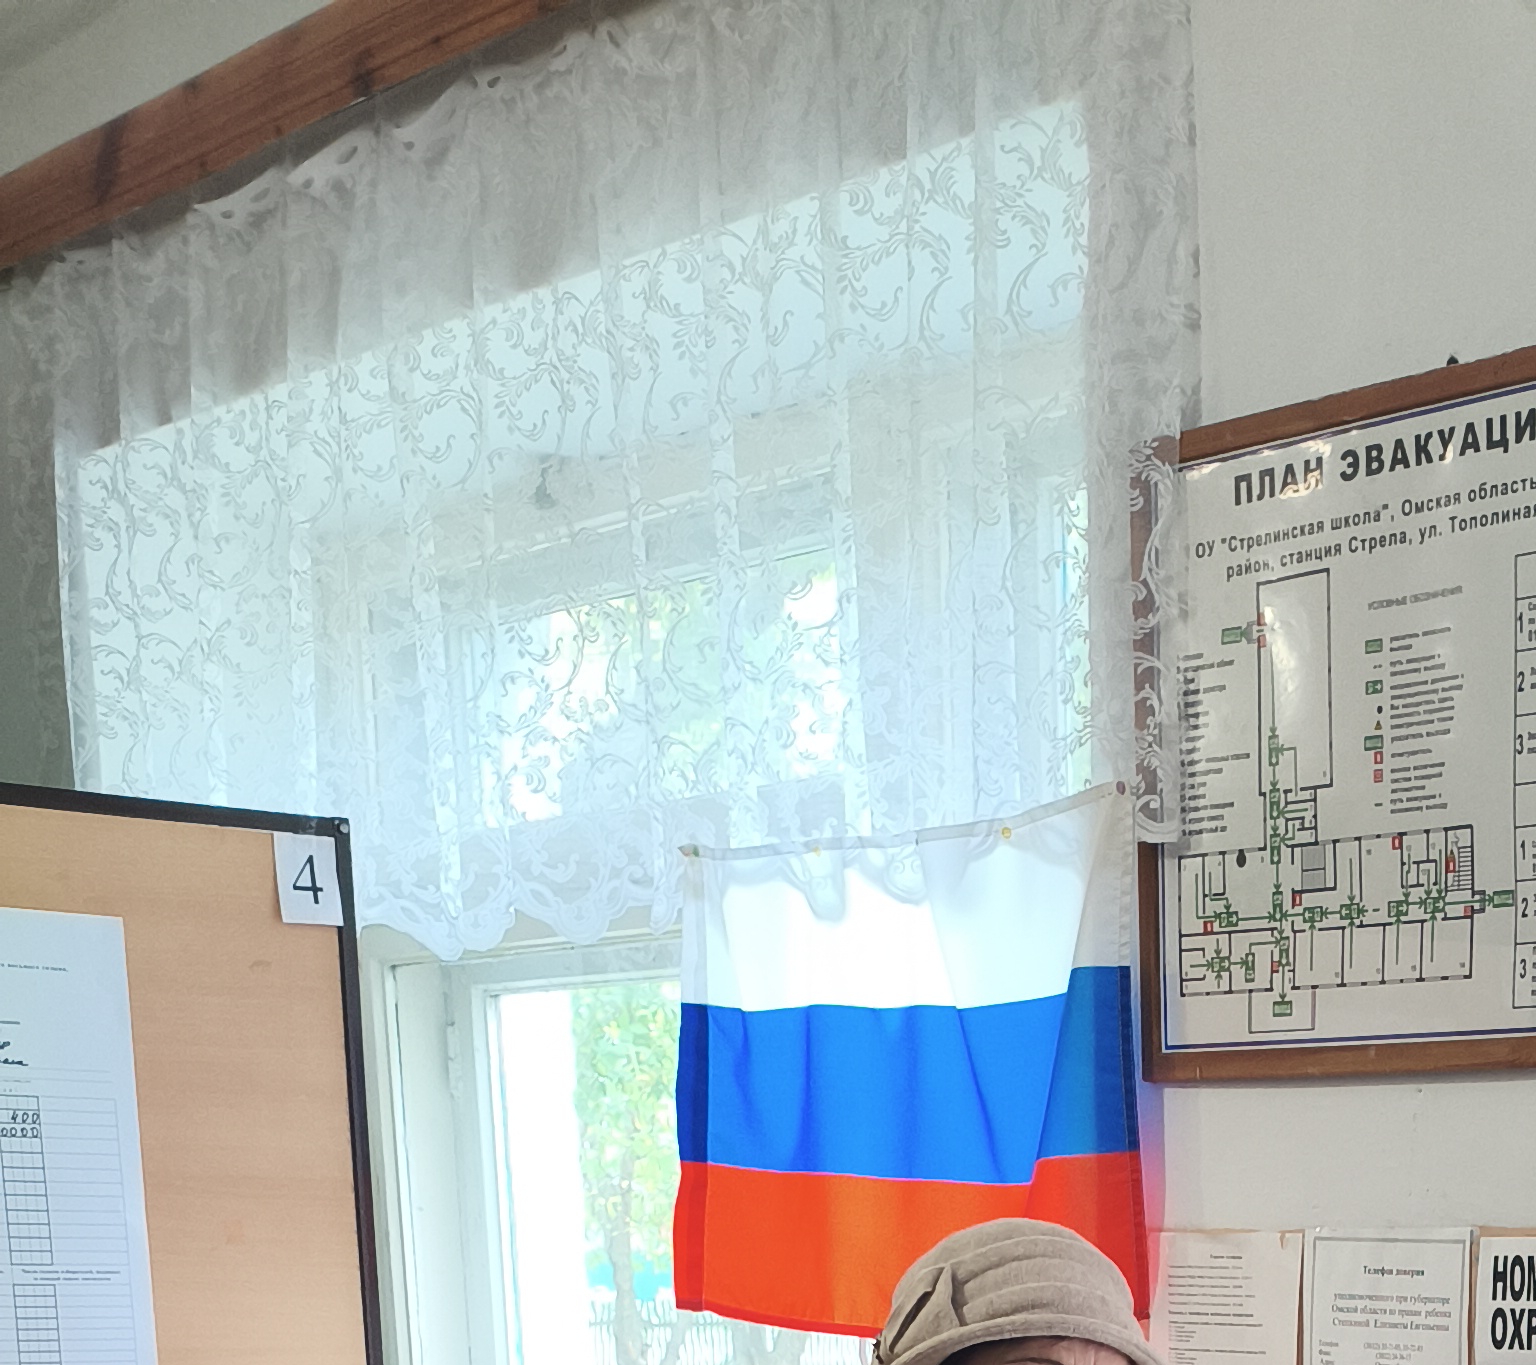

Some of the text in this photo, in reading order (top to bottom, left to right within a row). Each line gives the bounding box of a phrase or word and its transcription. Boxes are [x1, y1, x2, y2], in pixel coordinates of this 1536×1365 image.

[1234, 456, 1323, 506] ПЛАН
[1401, 491, 1461, 517] Омская
[1226, 557, 1275, 582] район,
[1280, 542, 1342, 568] станция
[1349, 530, 1413, 555] Стрела,
[1419, 523, 1442, 545] ул.
[1517, 671, 1525, 692] 2
[1516, 734, 1524, 755] 3
[1520, 840, 1526, 860] 1
[292, 854, 323, 905] 4
[1521, 898, 1528, 918] 2
[1520, 959, 1527, 979] 3
